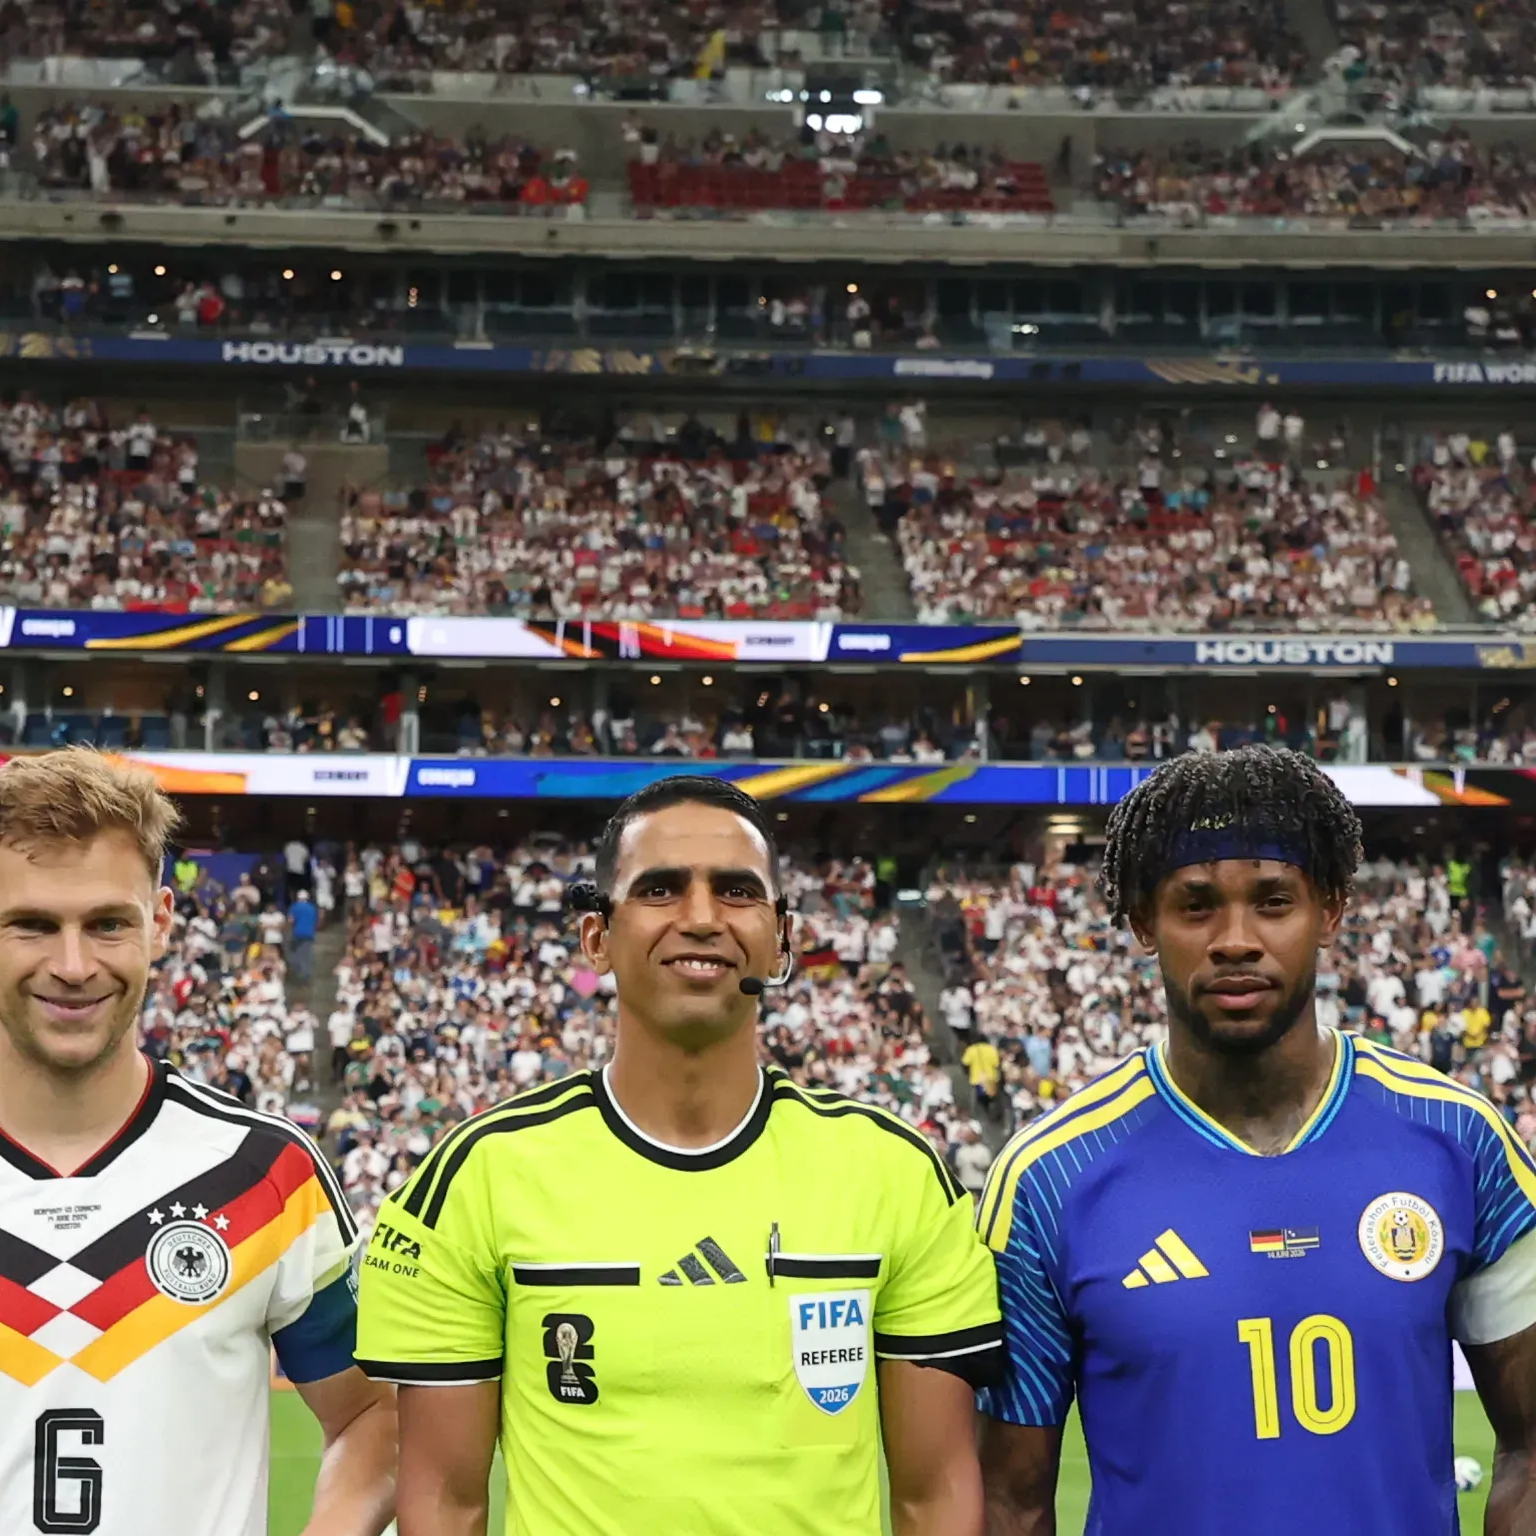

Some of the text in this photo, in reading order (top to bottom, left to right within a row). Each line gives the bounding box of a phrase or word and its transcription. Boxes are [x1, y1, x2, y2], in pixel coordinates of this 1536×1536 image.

[222, 340, 404, 366] HOUSTON
[1433, 363, 1483, 383] FIFA
[1195, 640, 1395, 664] HOUSTON
[371, 1222, 421, 1260] FIFA
[364, 1254, 420, 1278] EAM ONE
[799, 1299, 864, 1330] FIFA
[801, 1346, 864, 1366] REFEREE
[1237, 1314, 1356, 1440] 10
[559, 1386, 586, 1398] FIFA
[819, 1388, 849, 1404] 2026
[33, 1408, 104, 1535] 6
